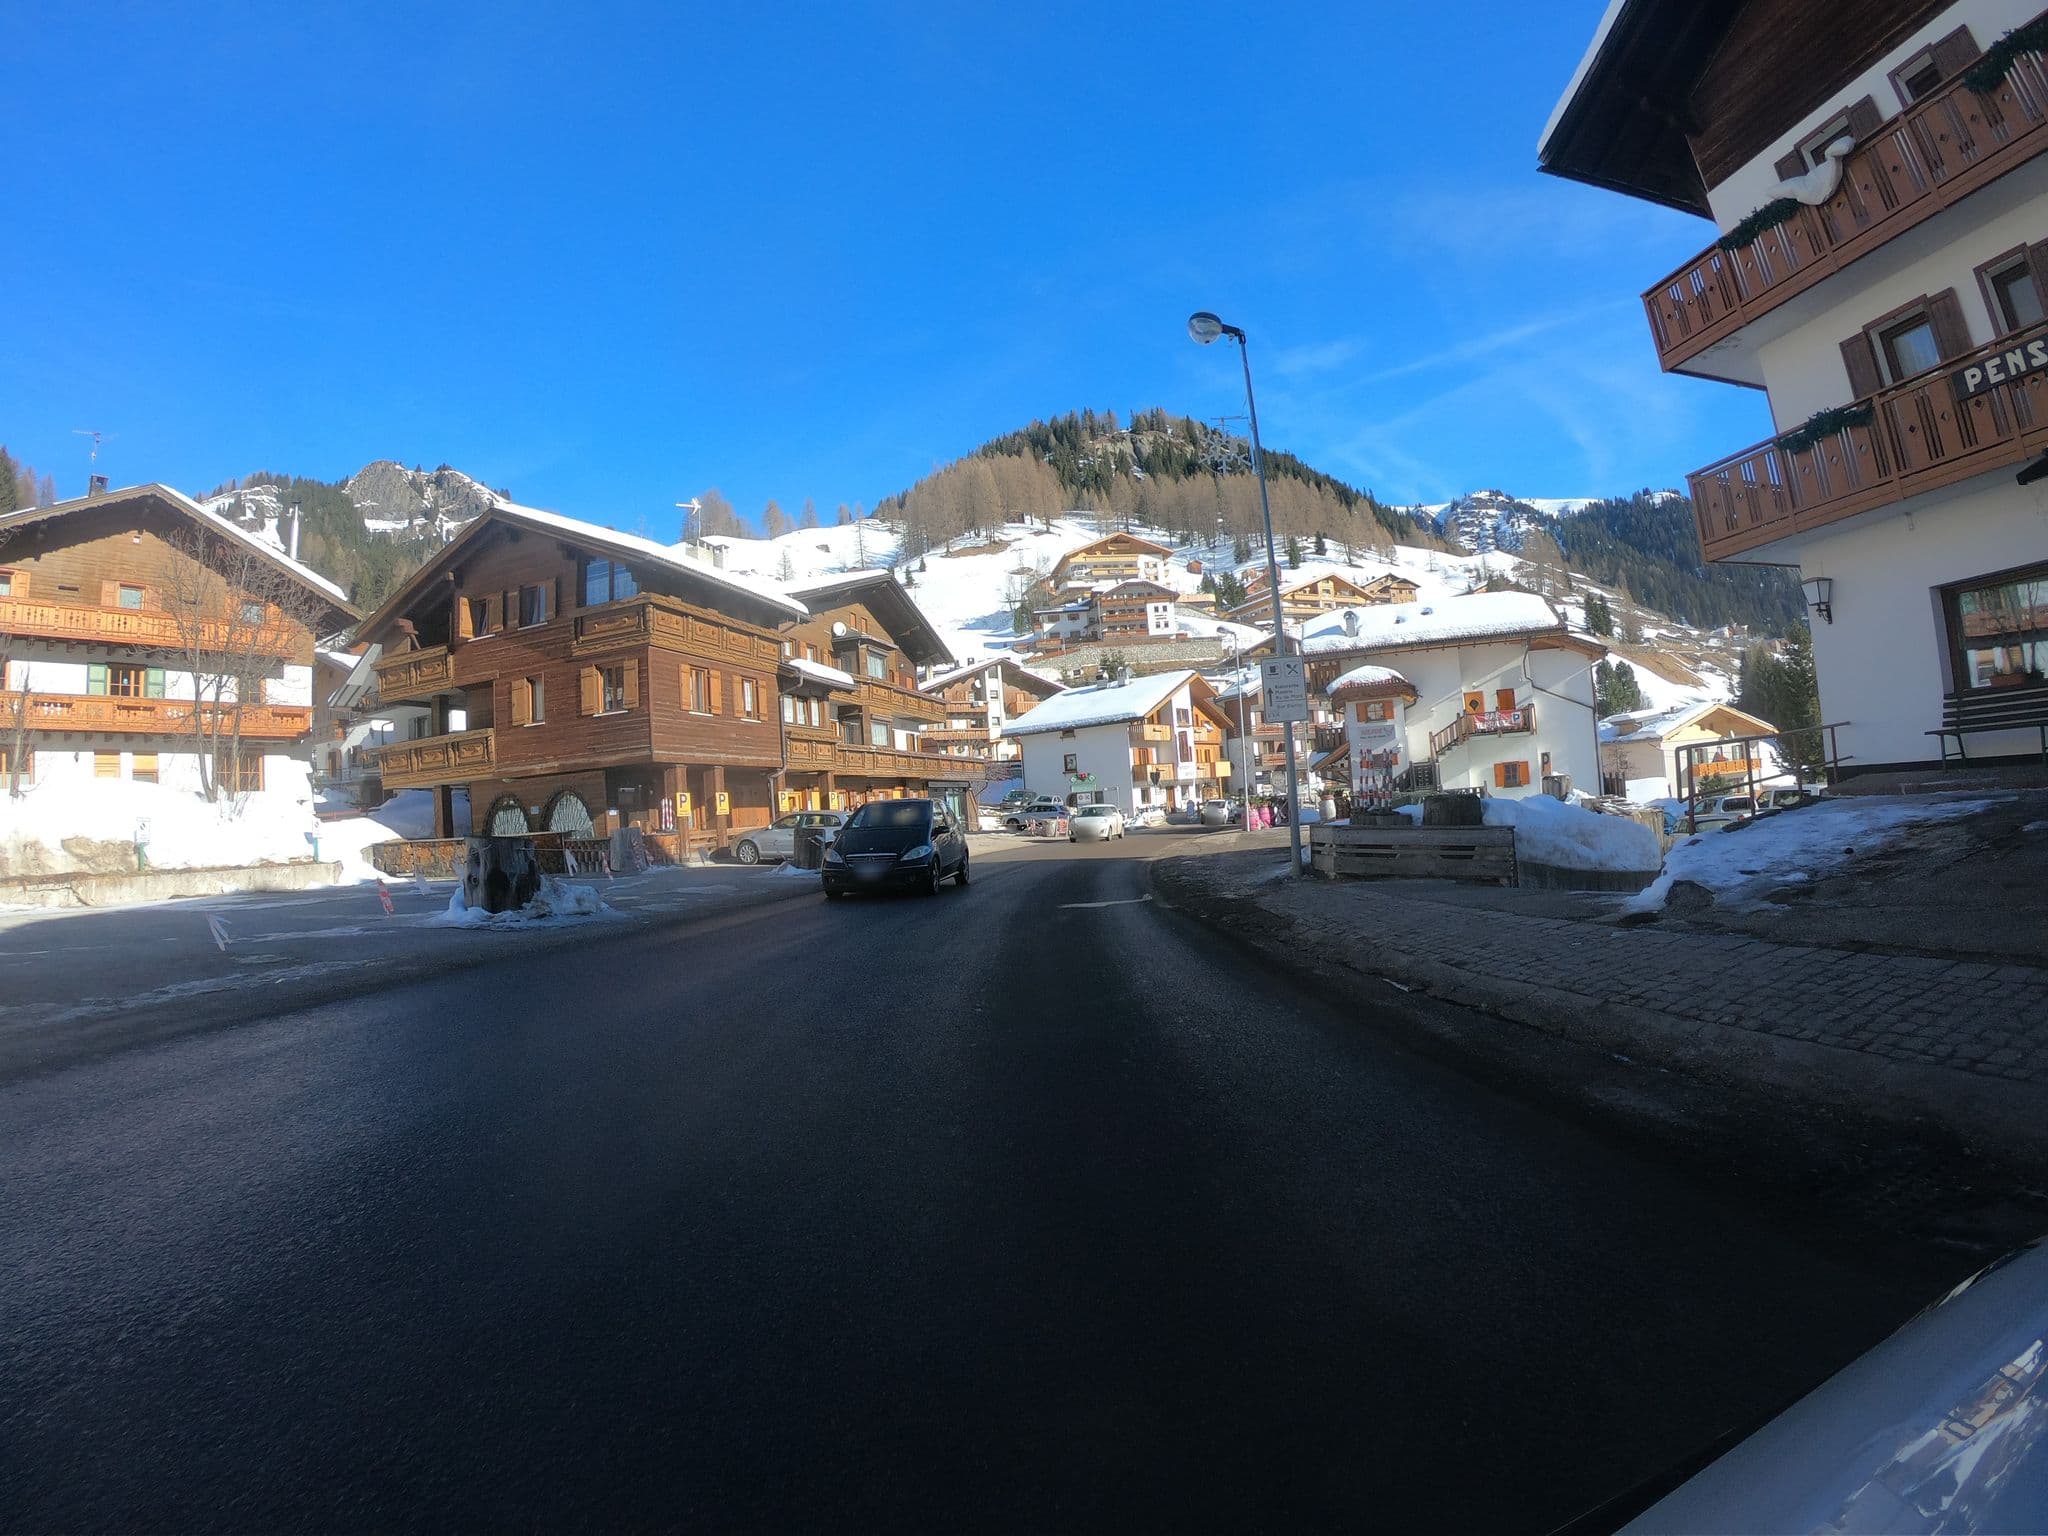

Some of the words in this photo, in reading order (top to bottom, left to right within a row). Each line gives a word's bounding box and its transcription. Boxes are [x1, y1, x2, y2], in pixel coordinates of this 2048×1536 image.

[1964, 341, 2048, 393] PENS
[680, 794, 687, 808] P
[719, 794, 726, 807] P
[781, 793, 786, 804] P
[831, 793, 836, 804] P
